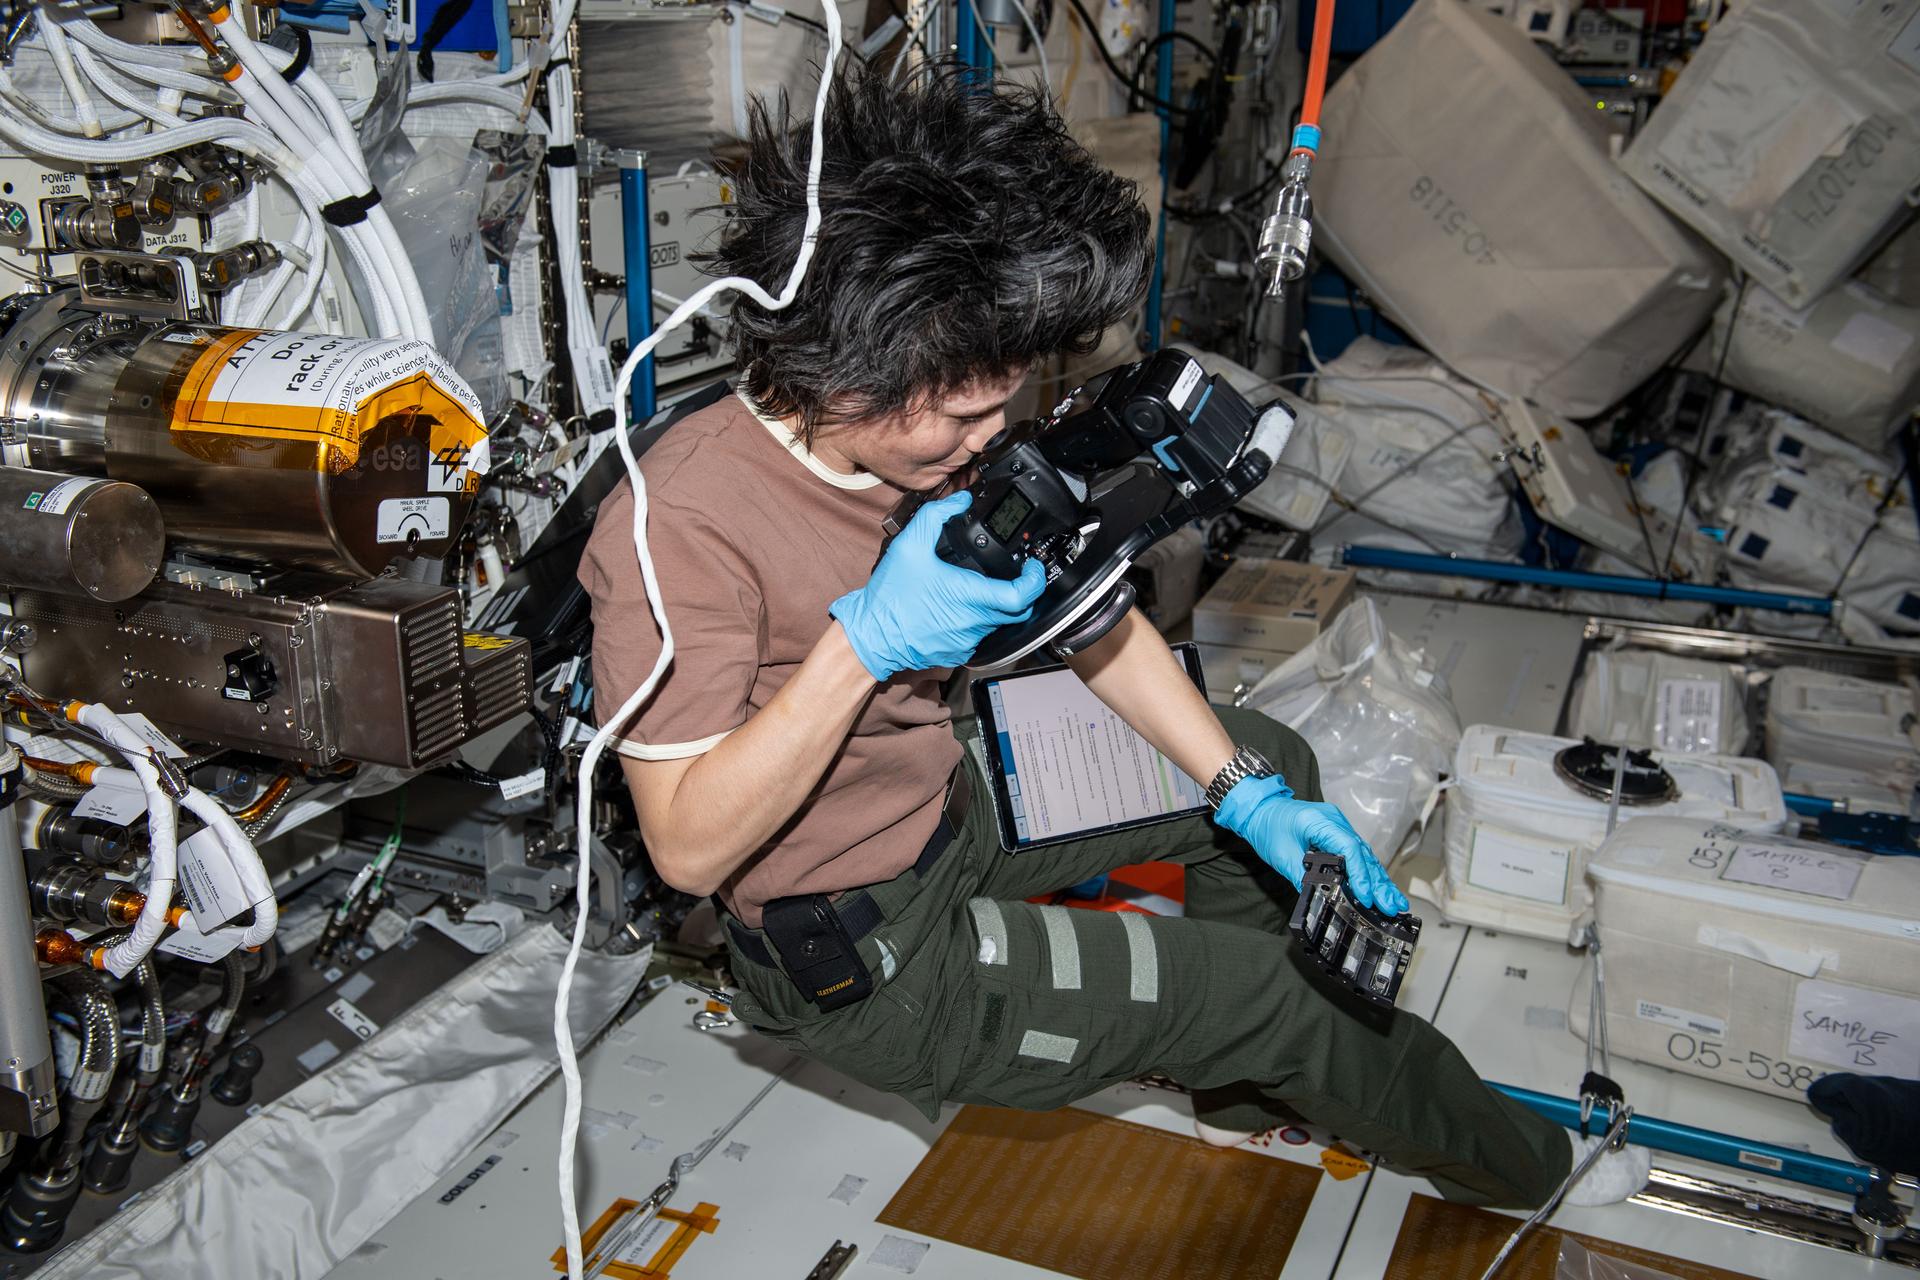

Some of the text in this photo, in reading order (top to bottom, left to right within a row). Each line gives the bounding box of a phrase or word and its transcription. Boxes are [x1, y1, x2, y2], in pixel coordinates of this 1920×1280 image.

[41, 172, 76, 184] POWER
[50, 185, 71, 195] J320
[146, 233, 187, 247] DATA J312
[271, 342, 304, 361] Do
[380, 347, 401, 361] very
[286, 354, 325, 391] rack
[310, 358, 343, 391] (During
[365, 371, 391, 389] while
[393, 356, 426, 377] science
[438, 369, 458, 393] being
[372, 444, 420, 471] esa
[455, 477, 478, 491] DLR
[816, 976, 855, 997] LEATHERMAN
[1802, 1010, 1899, 1044] SAMPLE
[1667, 1032, 1829, 1092] 0.5-538
[1846, 1043, 1877, 1067] B
